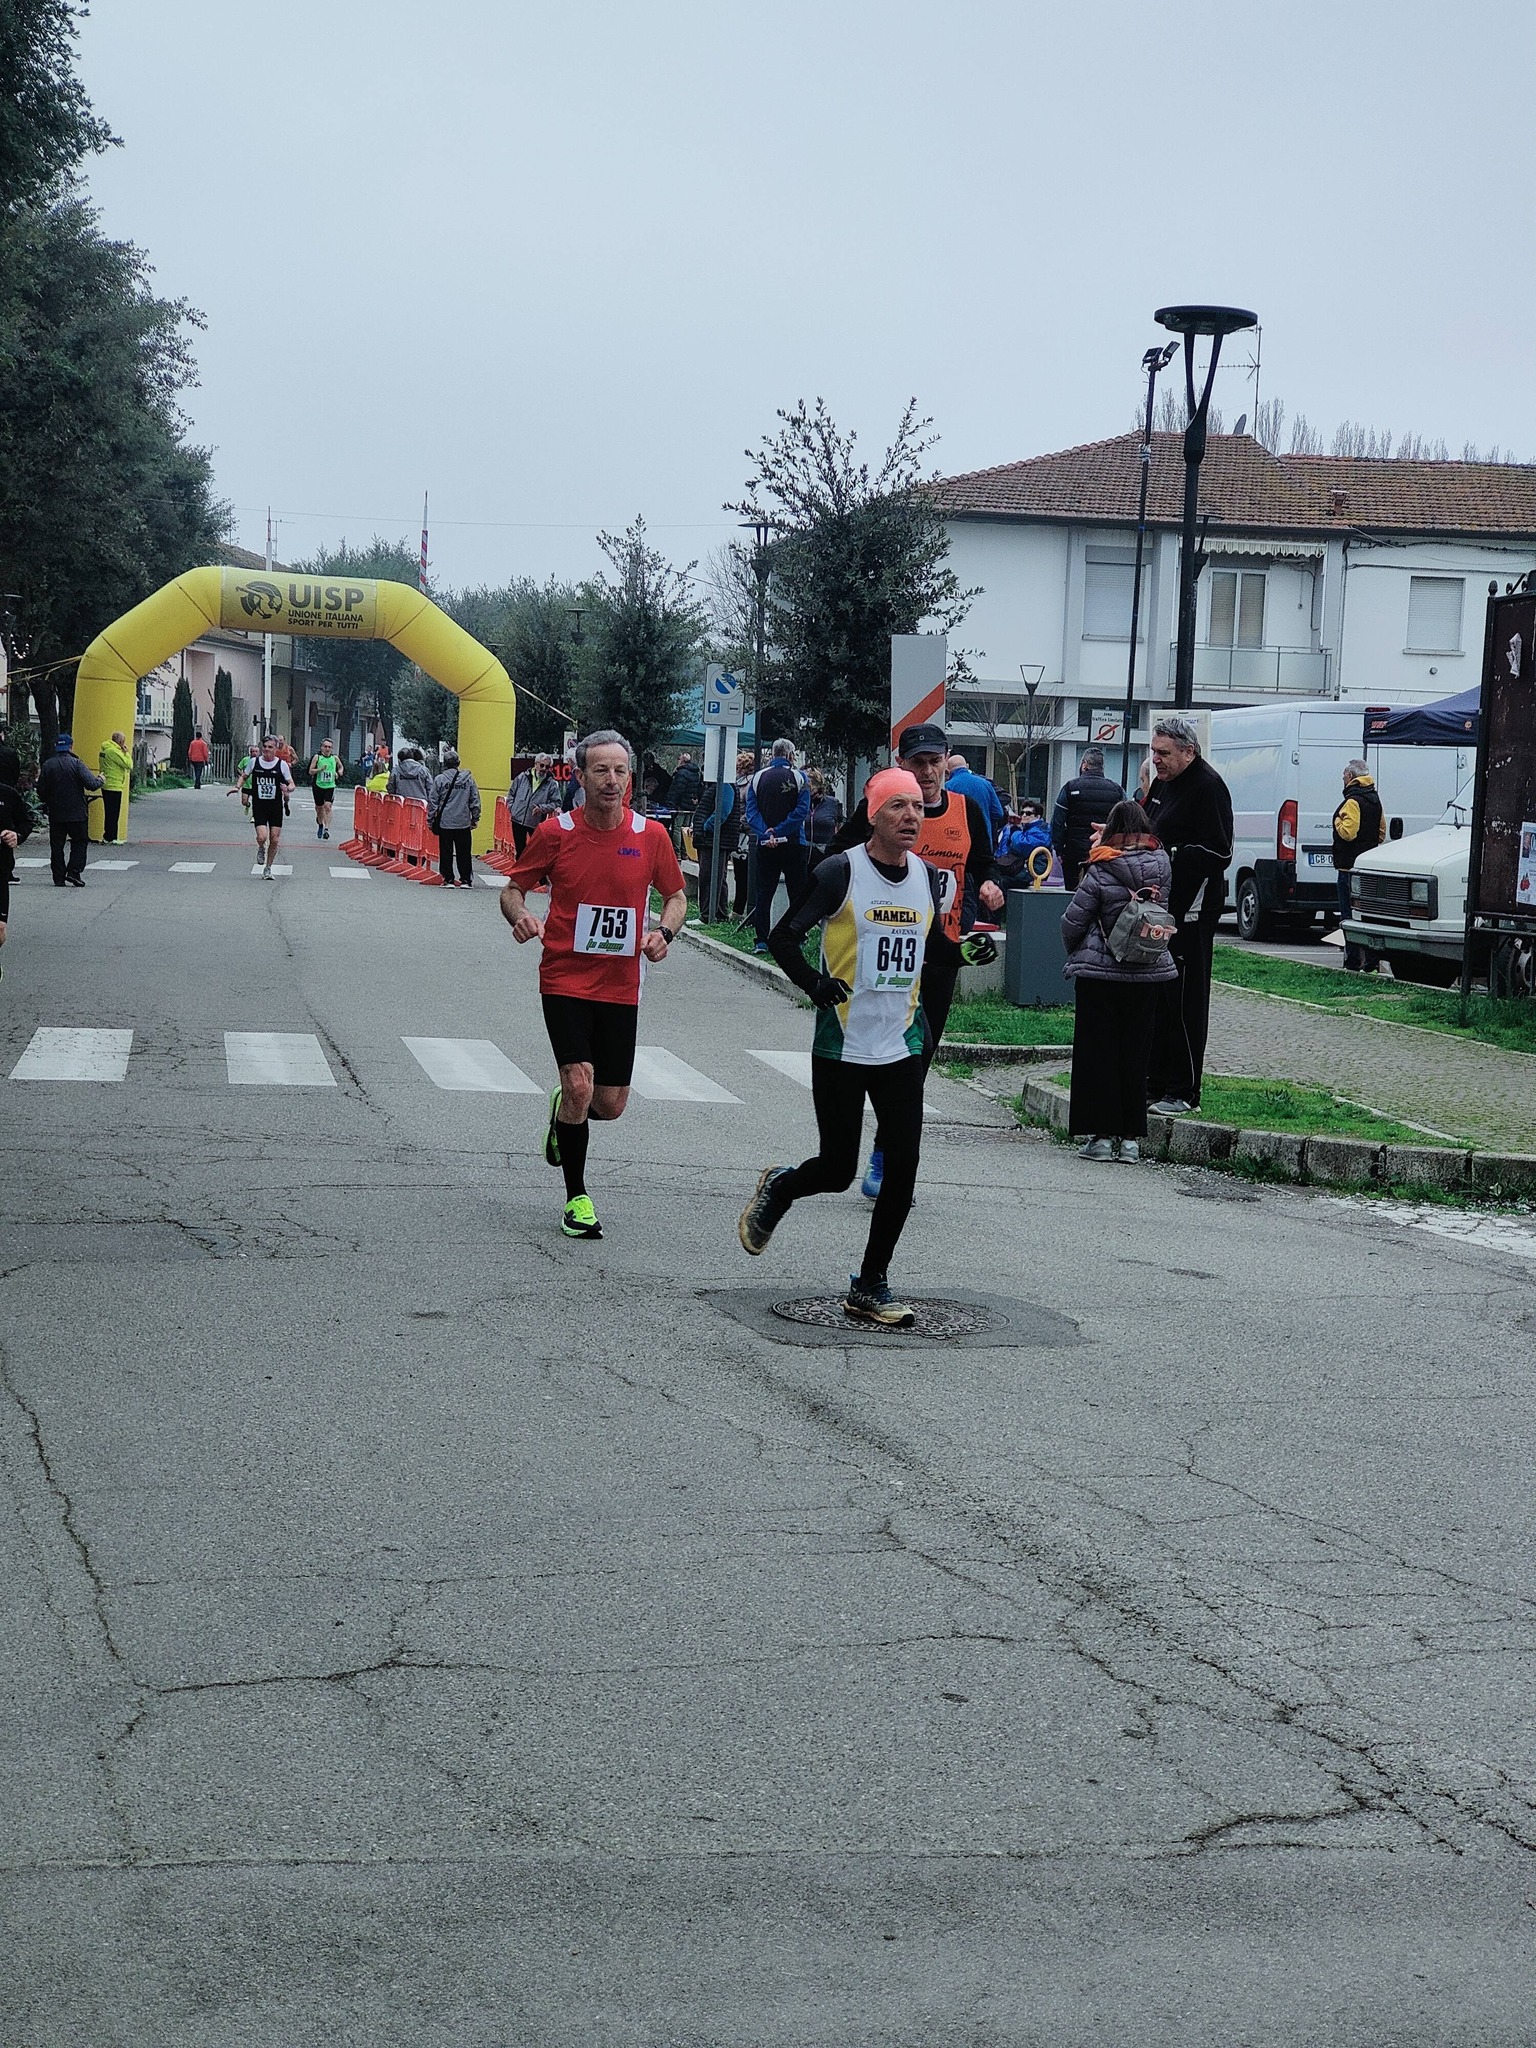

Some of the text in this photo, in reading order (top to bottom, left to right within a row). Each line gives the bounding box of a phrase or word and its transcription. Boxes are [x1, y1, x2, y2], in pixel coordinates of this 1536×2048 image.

[289, 583, 365, 612] UISP
[288, 610, 364, 622] UNIONE ITALIANA
[288, 619, 315, 627] SPORT
[318, 620, 333, 628] PER
[256, 776, 277, 786] LOLLI
[261, 785, 274, 796] 552
[917, 844, 964, 860] Lamone
[1315, 855, 1326, 864] GB
[872, 909, 917, 923] MAMELI
[589, 907, 629, 939] 753
[891, 928, 918, 936] RAVENNA
[876, 936, 917, 973] 643
